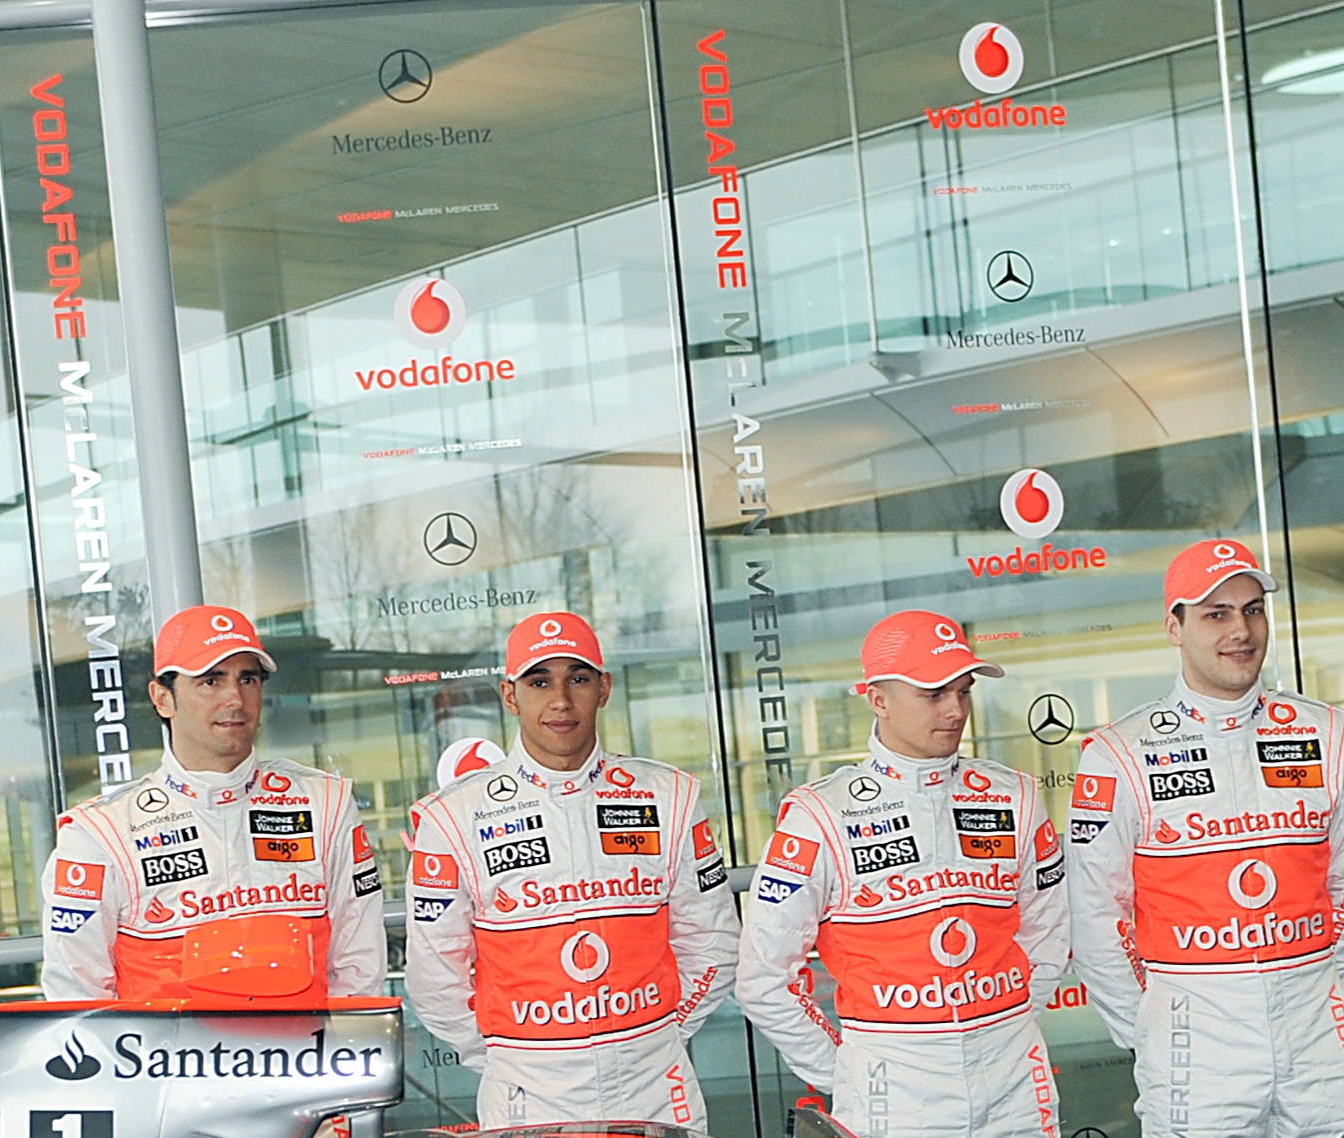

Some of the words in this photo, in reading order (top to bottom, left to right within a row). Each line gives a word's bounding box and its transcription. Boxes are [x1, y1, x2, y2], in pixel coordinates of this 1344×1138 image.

[925, 97, 1066, 129] vodafone
[332, 126, 492, 155] Mercedes-Benz
[395, 206, 443, 219] McLAREN
[445, 202, 500, 214] MERCEDES
[947, 326, 1085, 349] Mercedes-Benz
[355, 356, 515, 391] vodafone
[697, 29, 747, 289] VODAFONE
[746, 560, 793, 786] MERCEDE
[30, 73, 87, 340] VODAFONE
[84, 615, 133, 796] MERCE
[468, 438, 522, 451] MERCEDES
[967, 543, 1106, 577] vodafone
[377, 588, 537, 618] Mercedes-Benz
[529, 637, 577, 651] vodafone
[383, 671, 439, 685] VODAFONE
[440, 667, 488, 680] McLAREN
[1177, 701, 1206, 723] FedEx
[1257, 725, 1316, 735] vodafone
[871, 759, 903, 781] FedEx
[1145, 751, 1190, 766] Mobil
[165, 774, 198, 799] FedEx
[517, 764, 547, 789] FedEx
[1153, 772, 1211, 793] BOSS
[1275, 767, 1307, 786] aigo
[250, 794, 310, 805] vodafone
[595, 788, 654, 799] vodafone
[952, 793, 1011, 803] vodafone
[479, 818, 525, 842] Mobil
[846, 820, 892, 840] Mobil
[1072, 822, 1099, 840] SAP
[1186, 800, 1330, 840] Santander
[135, 830, 181, 852] Mobil
[267, 841, 299, 859] aigo
[614, 834, 645, 852] aigo
[971, 838, 1002, 857] aigo
[146, 852, 204, 878] BOSS
[487, 840, 546, 868] BOSS
[855, 840, 915, 867] BOSS
[521, 867, 663, 909] Santander
[760, 880, 791, 901] SAP
[886, 863, 1020, 901] Santander
[179, 873, 326, 919] Santander
[51, 910, 85, 930] SAP
[415, 900, 444, 919] SAP
[1172, 912, 1324, 950] vodafone
[675, 966, 719, 1027] ntander
[873, 966, 1025, 1008] vodafone
[512, 982, 661, 1026] vodafone
[114, 1029, 382, 1079] Santander
